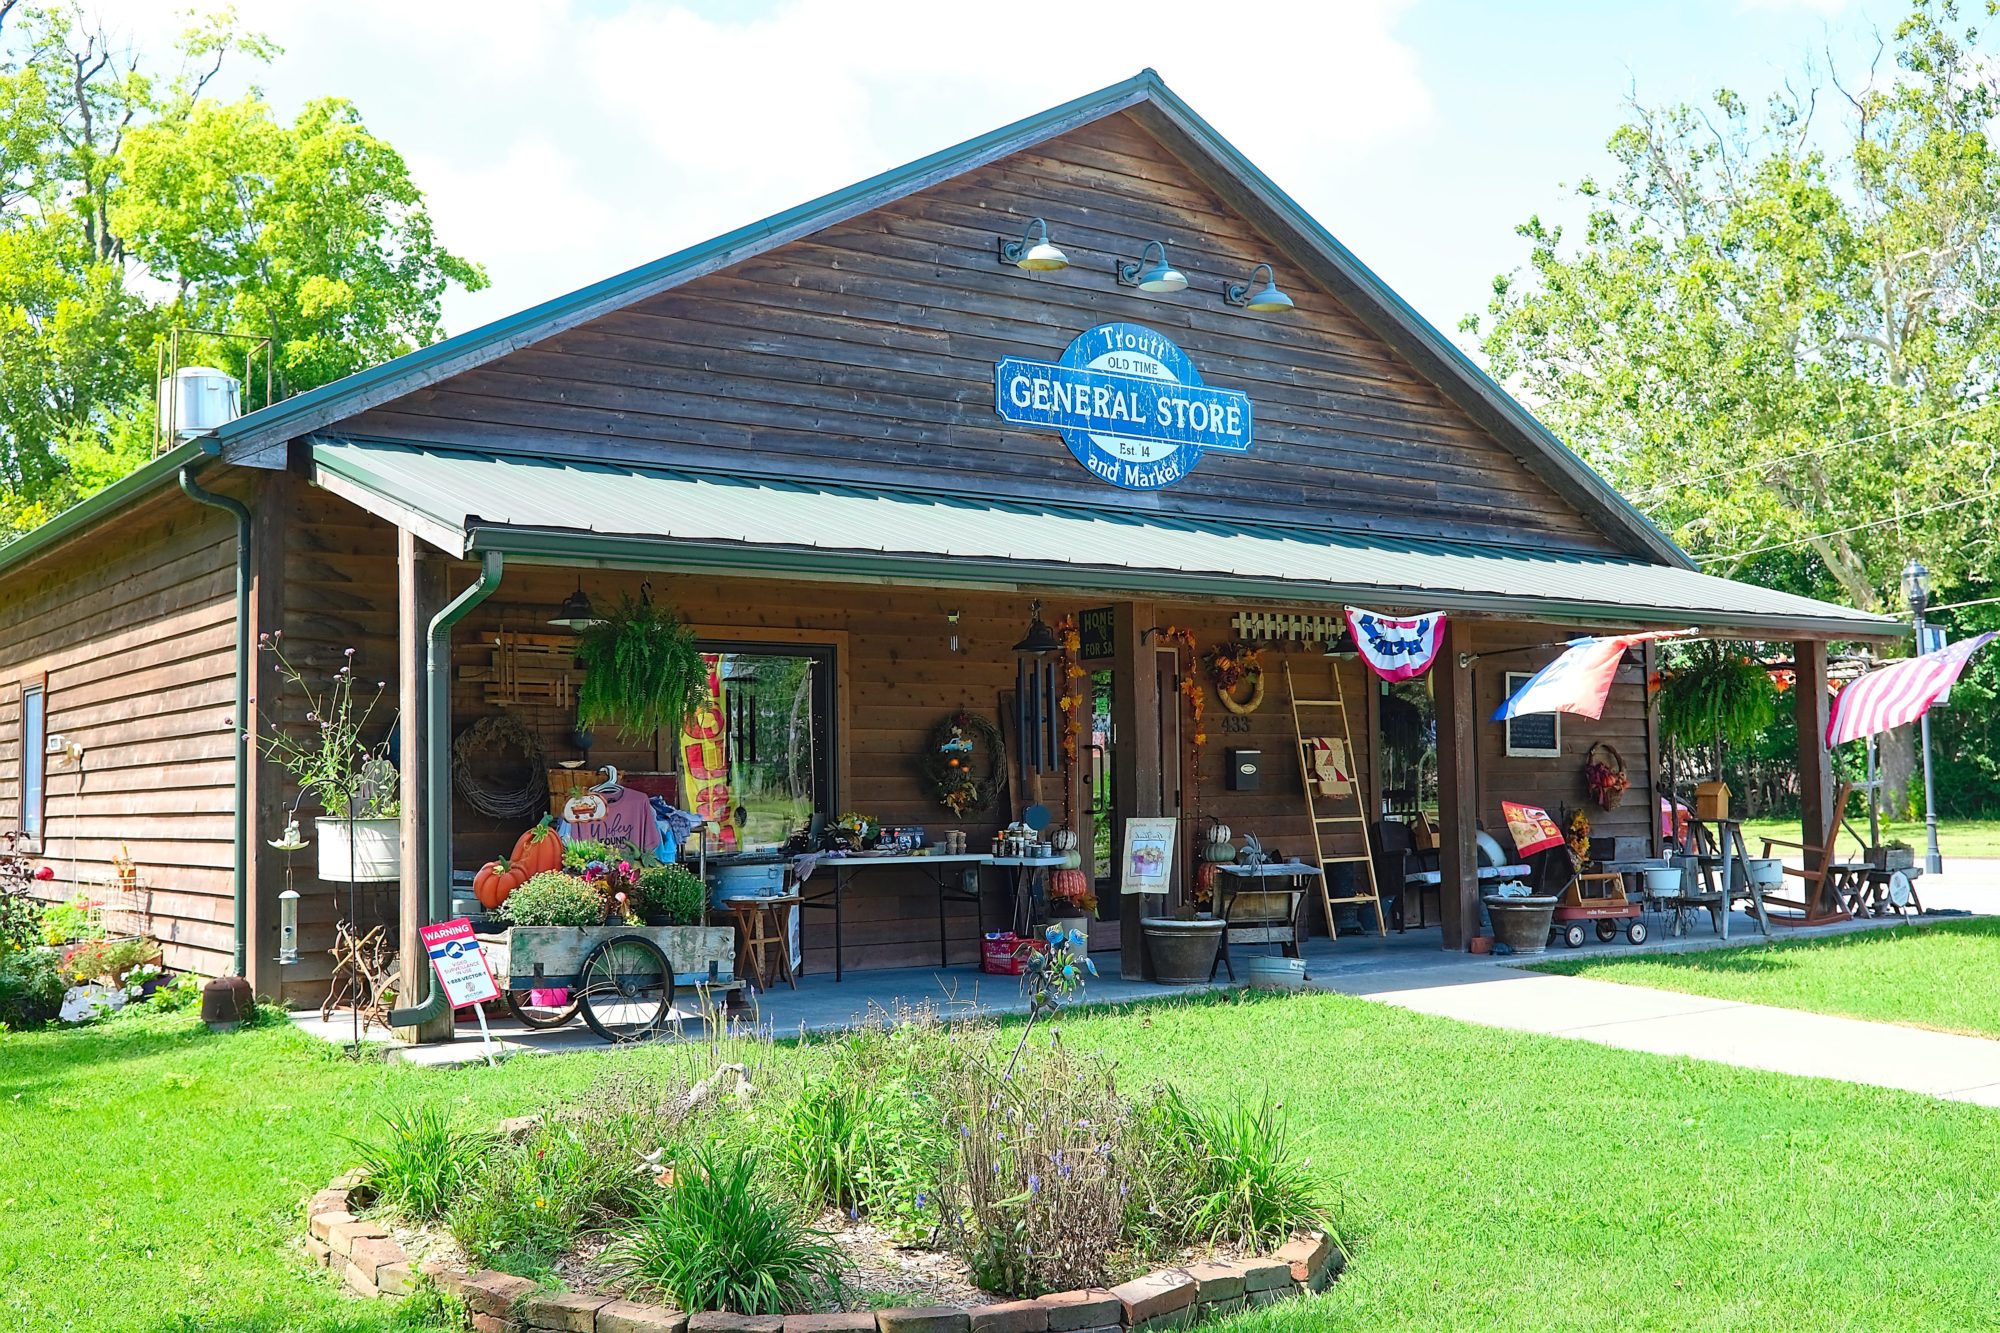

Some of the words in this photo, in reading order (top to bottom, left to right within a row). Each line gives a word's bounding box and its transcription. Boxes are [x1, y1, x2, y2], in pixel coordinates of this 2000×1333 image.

[1108, 356, 1130, 371] OLD
[1134, 360, 1158, 375] TIME
[1010, 375, 1147, 424] GENERAL
[1156, 396, 1243, 436] STORE
[1087, 453, 1119, 482] and
[1124, 460, 1182, 487] Market
[1084, 611, 1114, 632] HONE
[1085, 642, 1101, 656] FOR
[1102, 641, 1114, 655] SA
[1221, 715, 1249, 733] 433
[591, 813, 635, 843] Wifey
[424, 925, 469, 941] WARNING
